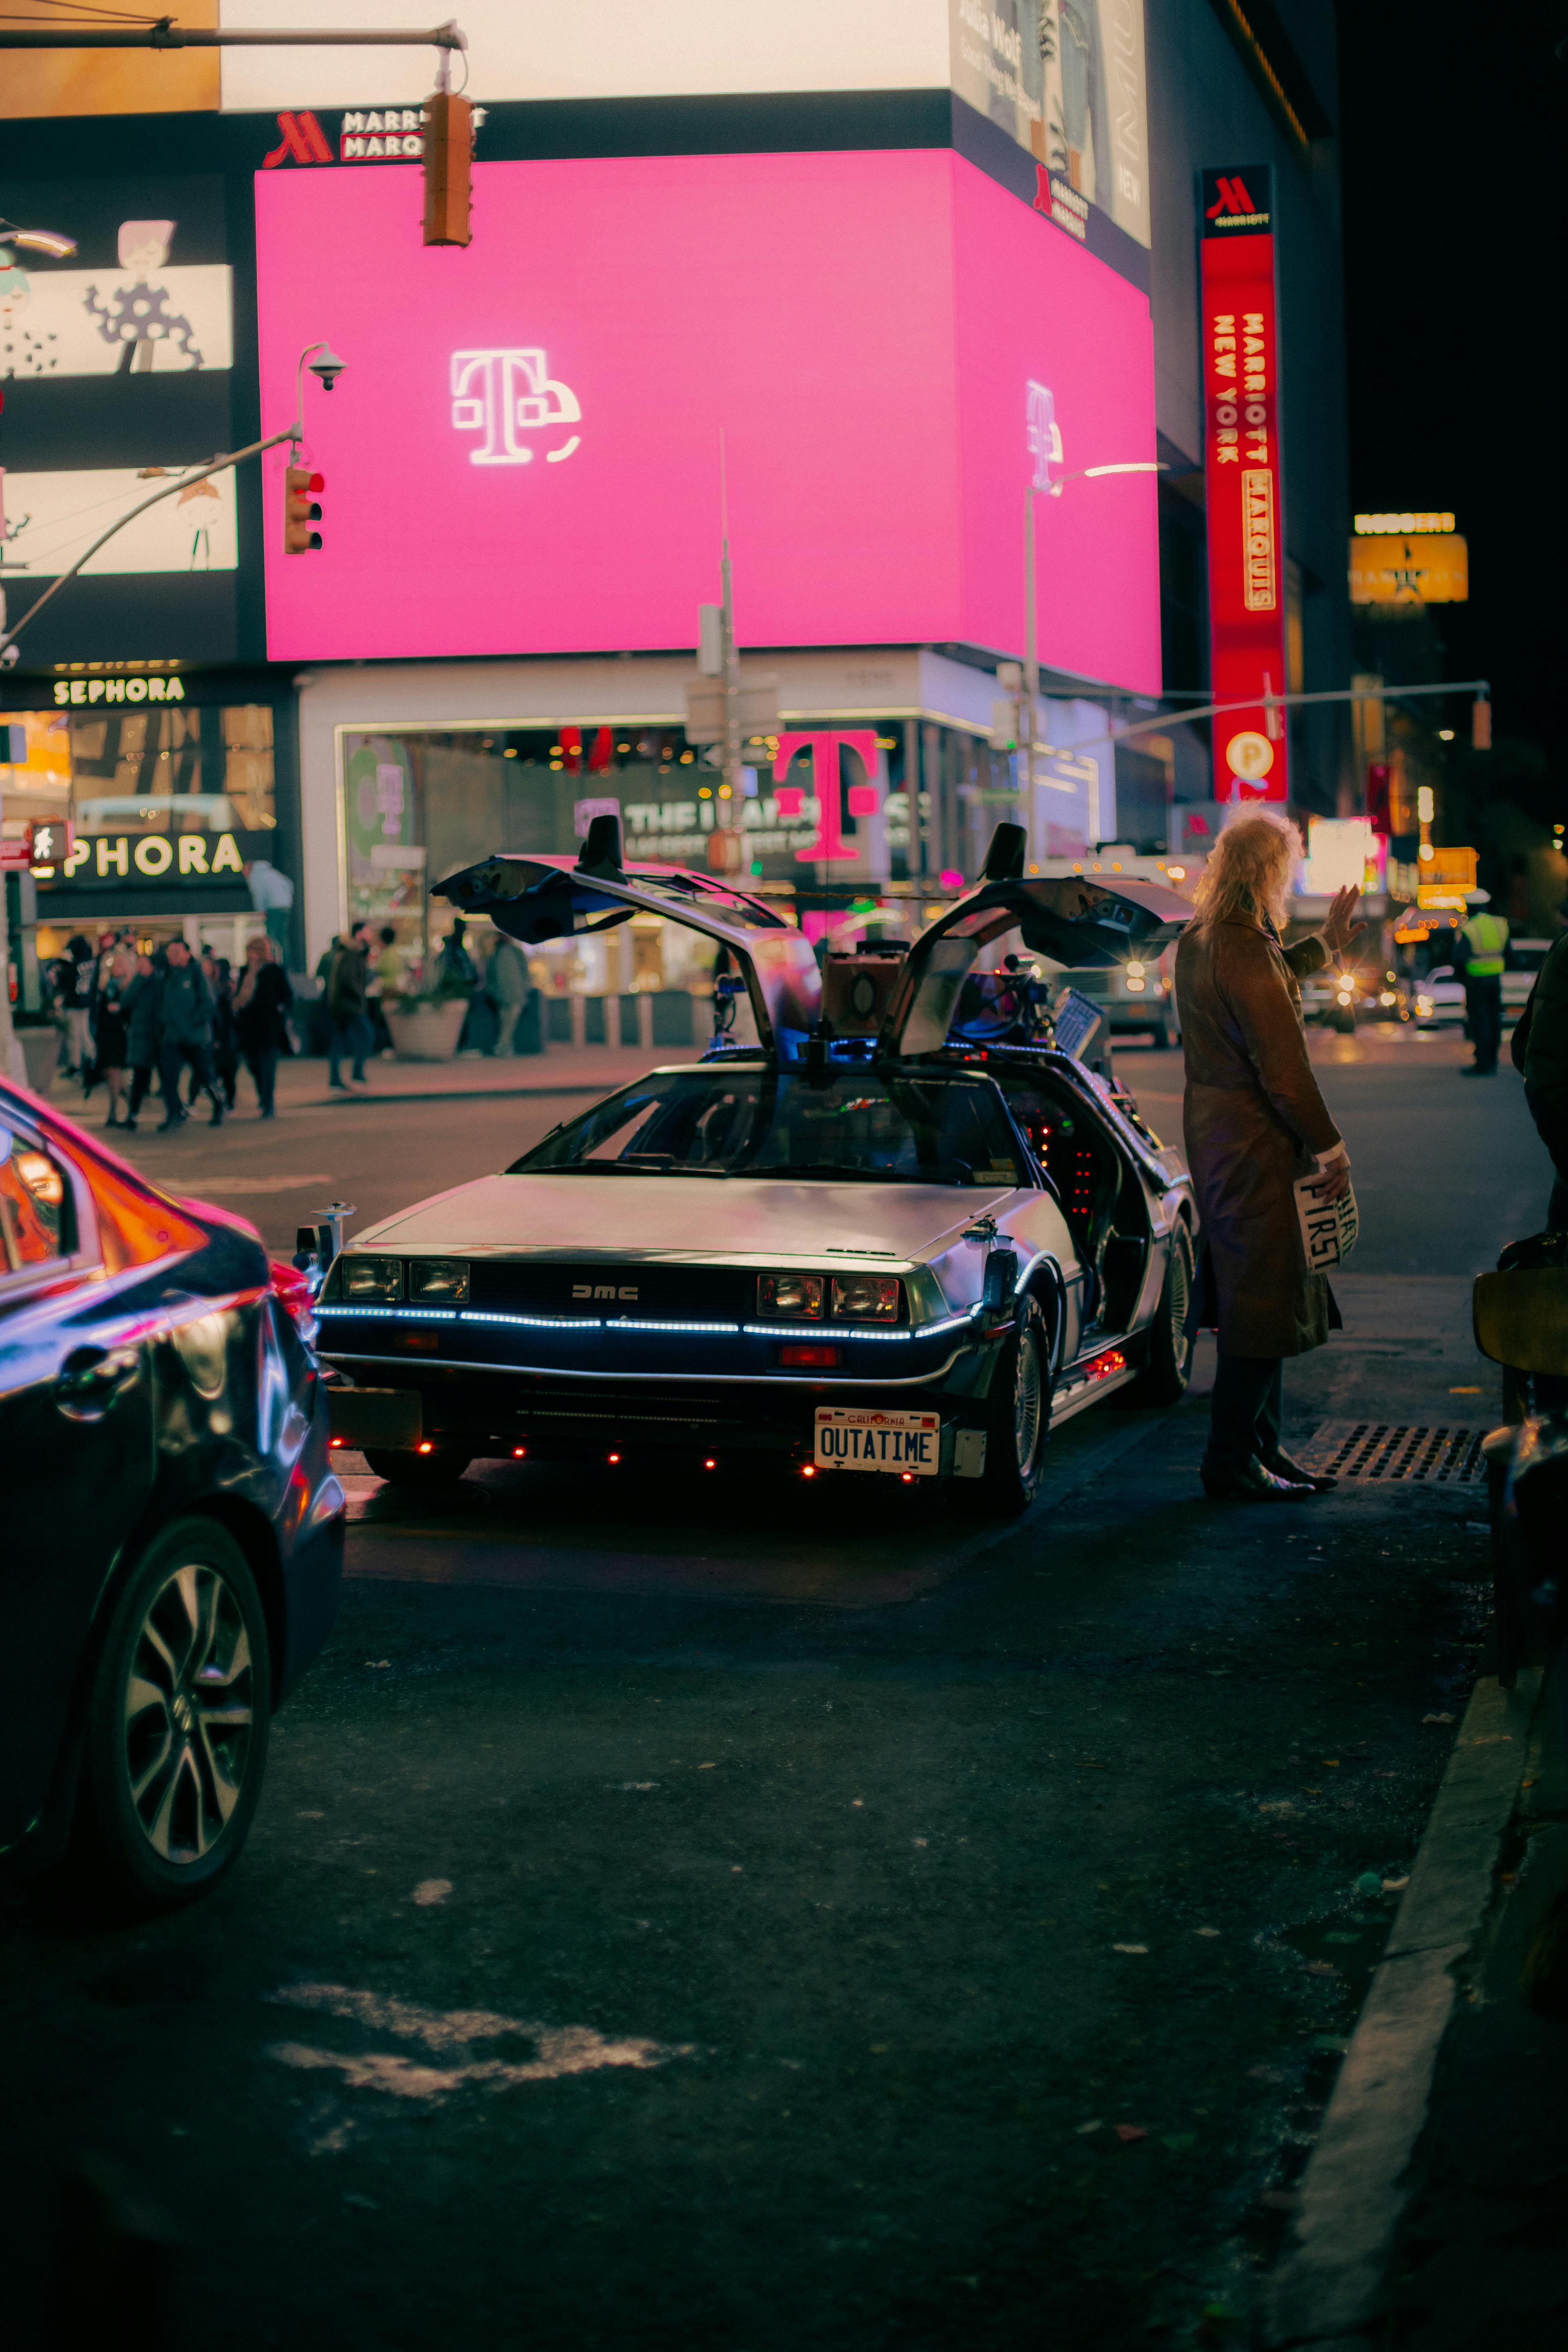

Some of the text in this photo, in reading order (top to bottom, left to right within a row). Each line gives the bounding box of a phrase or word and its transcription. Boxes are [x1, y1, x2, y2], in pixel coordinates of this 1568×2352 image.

[1214, 314, 1238, 464] NEW YORK
[1242, 313, 1268, 464] MARRIOTT
[1247, 474, 1272, 607] MARQUIS
[54, 677, 185, 705] SEPHORA
[821, 1428, 932, 1463] OUTATIME
[848, 1414, 904, 1426] CALIFORNIA
